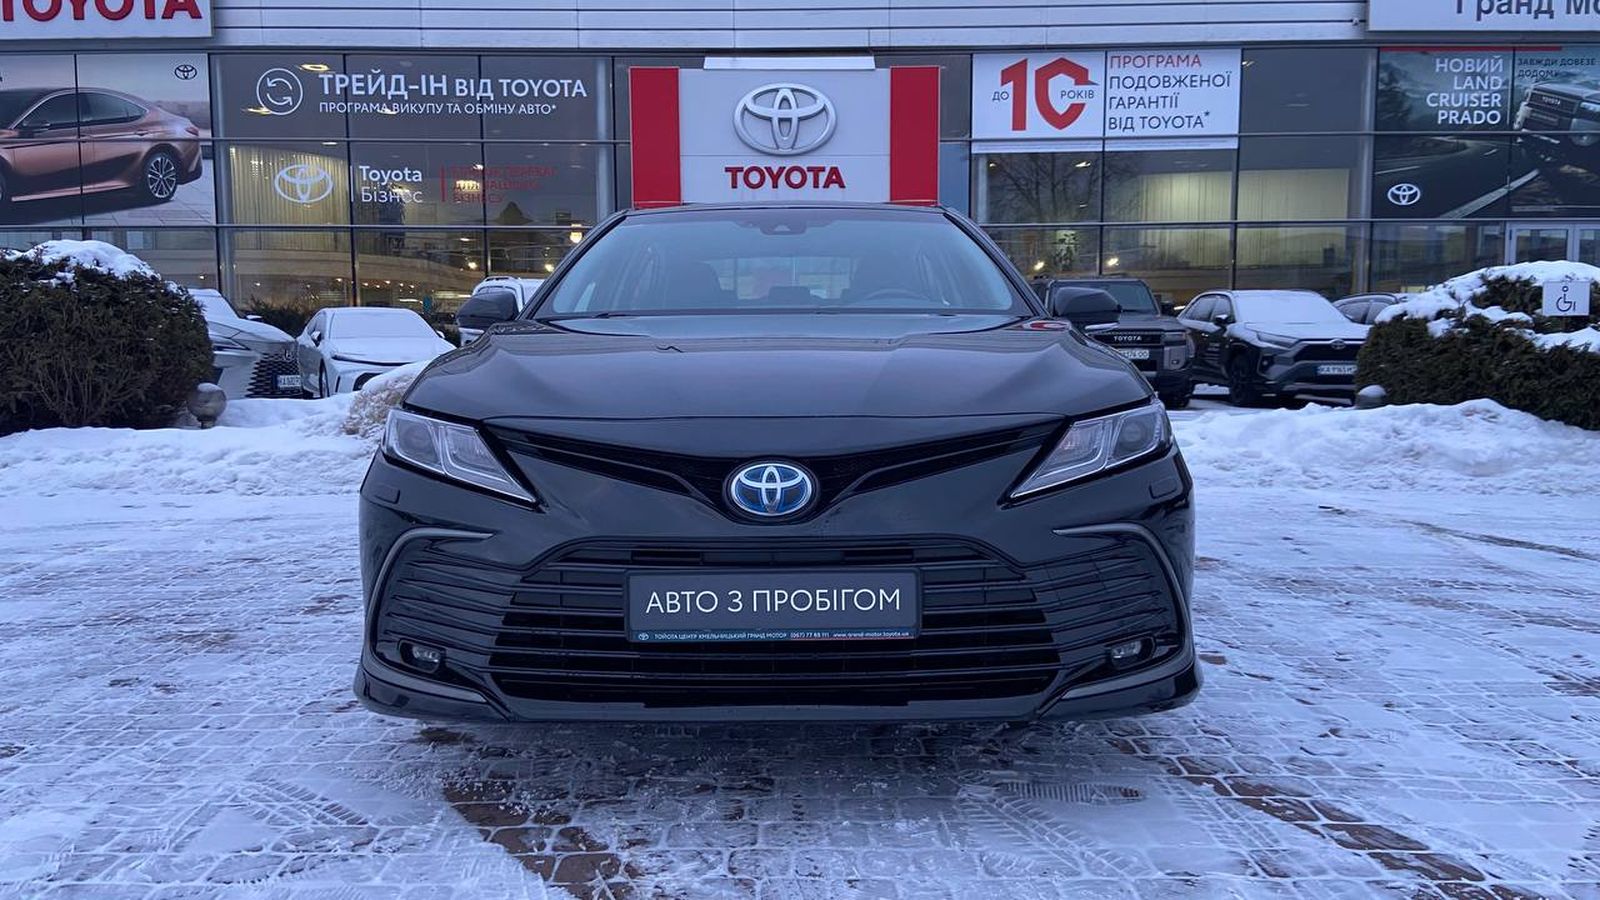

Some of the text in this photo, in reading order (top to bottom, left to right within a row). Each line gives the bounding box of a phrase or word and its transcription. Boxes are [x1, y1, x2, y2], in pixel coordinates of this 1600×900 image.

[1109, 54, 1202, 69] ПРОГРАМА
[1435, 55, 1504, 73] НОВИЙ
[318, 69, 588, 100] ТРЕЙД-ІН ВІД TOYOTA
[1109, 71, 1232, 92] ПОДОВЖЕНОЇ
[1454, 76, 1503, 90] LAND
[992, 91, 1009, 102] ДО
[1060, 90, 1095, 100] РОКІВ
[1109, 92, 1180, 110] ГАРАНТІЇ
[1426, 92, 1502, 108] CRUISER
[319, 103, 388, 115] ПРОГРАМА
[392, 103, 443, 115] ВИКУПУ
[446, 103, 462, 115] ТА
[464, 103, 515, 115] ОБМІНУ
[1108, 117, 1135, 132] ВІД
[1437, 110, 1502, 125] PRADO
[359, 165, 422, 186] Toyota
[725, 165, 846, 189] TOYOTA
[645, 589, 900, 613] АВТО З ПРОБІГОМ
[654, 632, 678, 640] ТОЙОТА
